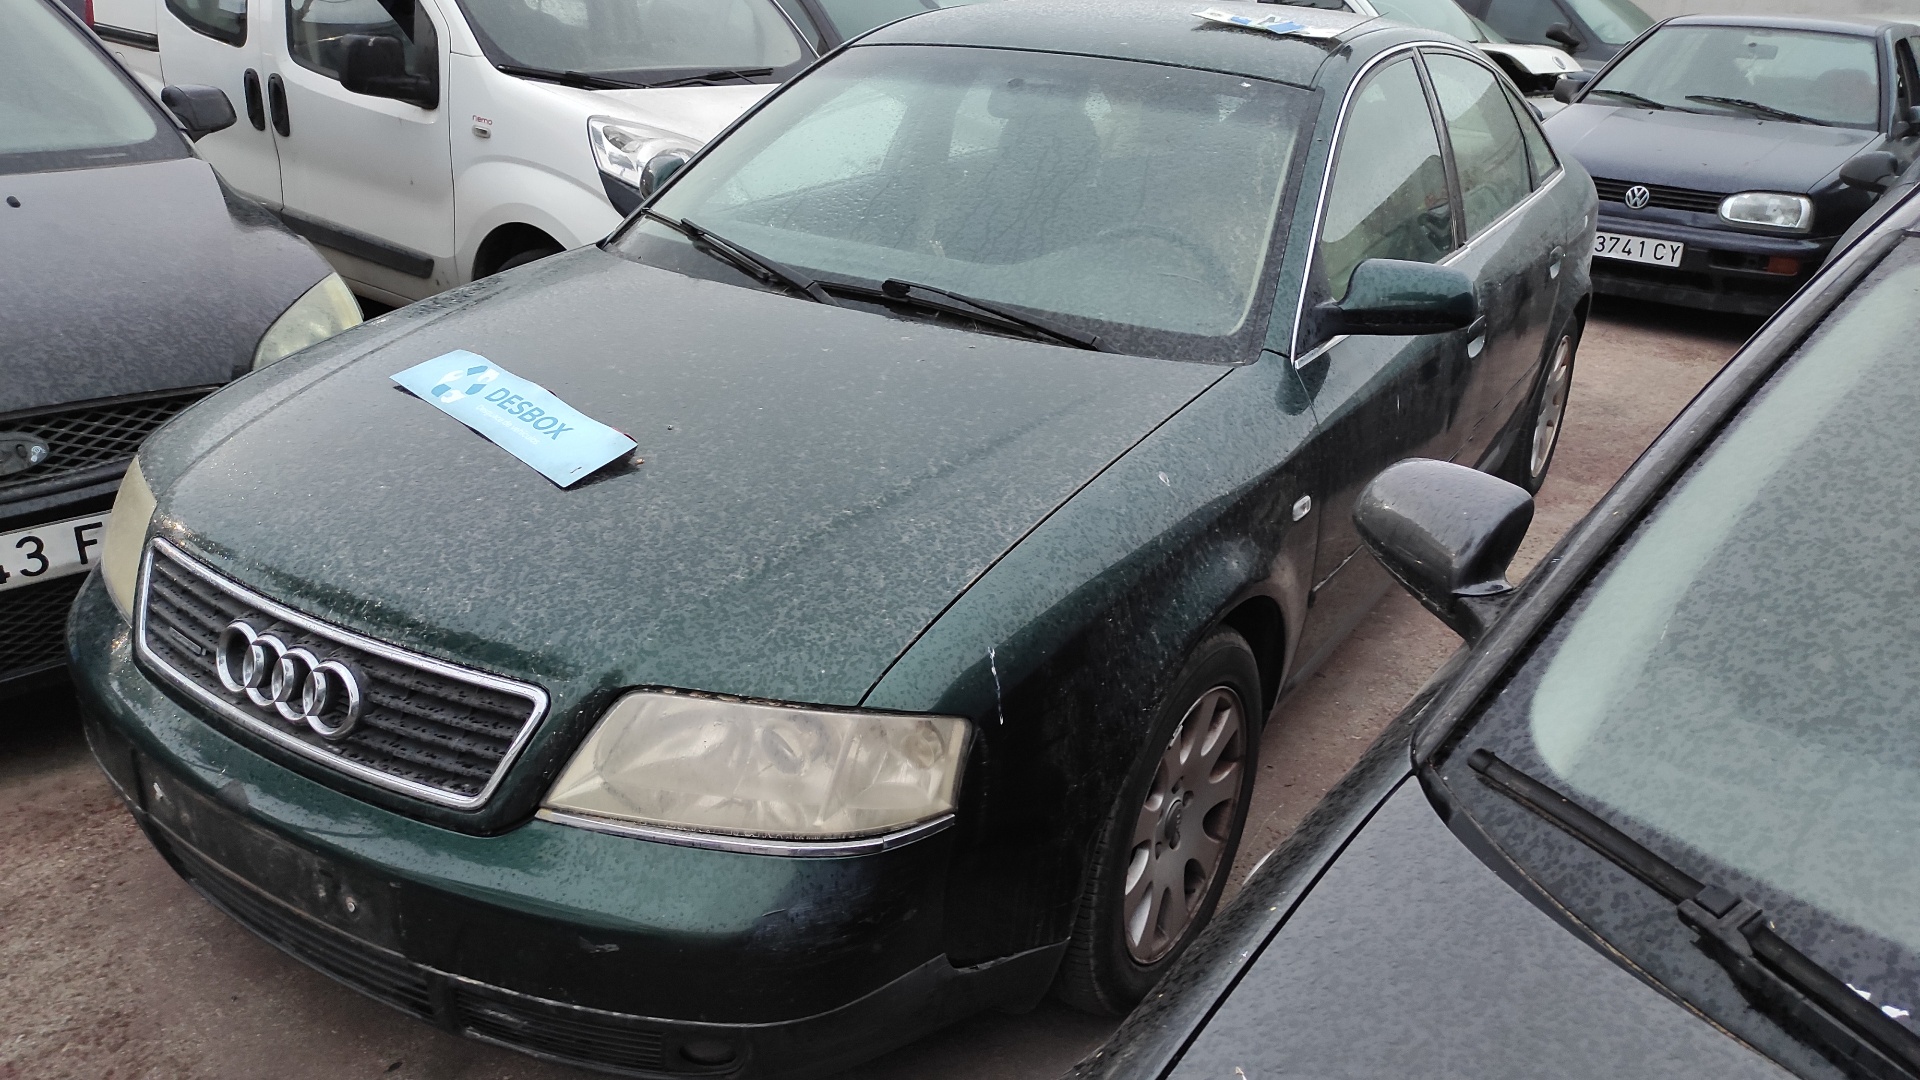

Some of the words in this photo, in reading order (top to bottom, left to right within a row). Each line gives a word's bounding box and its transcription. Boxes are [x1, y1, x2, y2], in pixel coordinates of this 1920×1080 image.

[472, 114, 493, 126] nemo
[1595, 236, 1645, 258] 3741
[1654, 243, 1681, 262] CY
[484, 387, 575, 440] DESBOX
